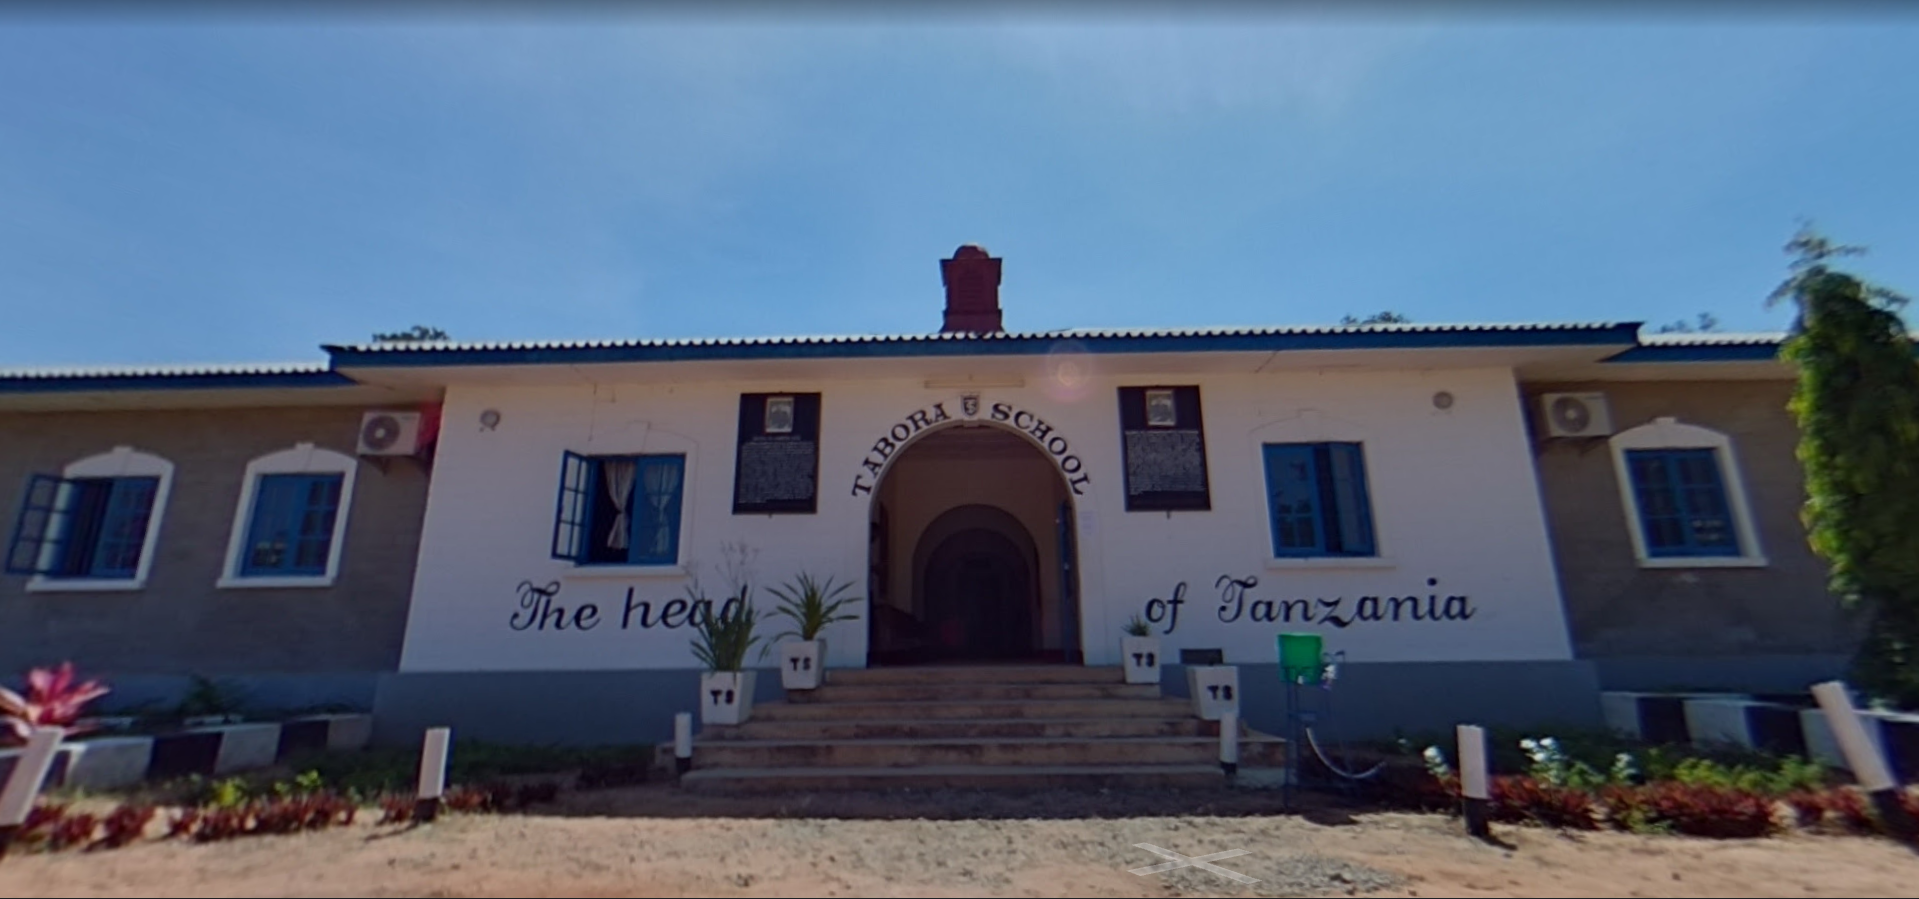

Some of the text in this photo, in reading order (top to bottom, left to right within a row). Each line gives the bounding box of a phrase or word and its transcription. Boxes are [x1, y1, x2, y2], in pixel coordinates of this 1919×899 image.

[852, 402, 951, 497] TABORA
[991, 402, 1091, 496] SCHOOL
[510, 575, 1475, 635] The head of Tanzania
